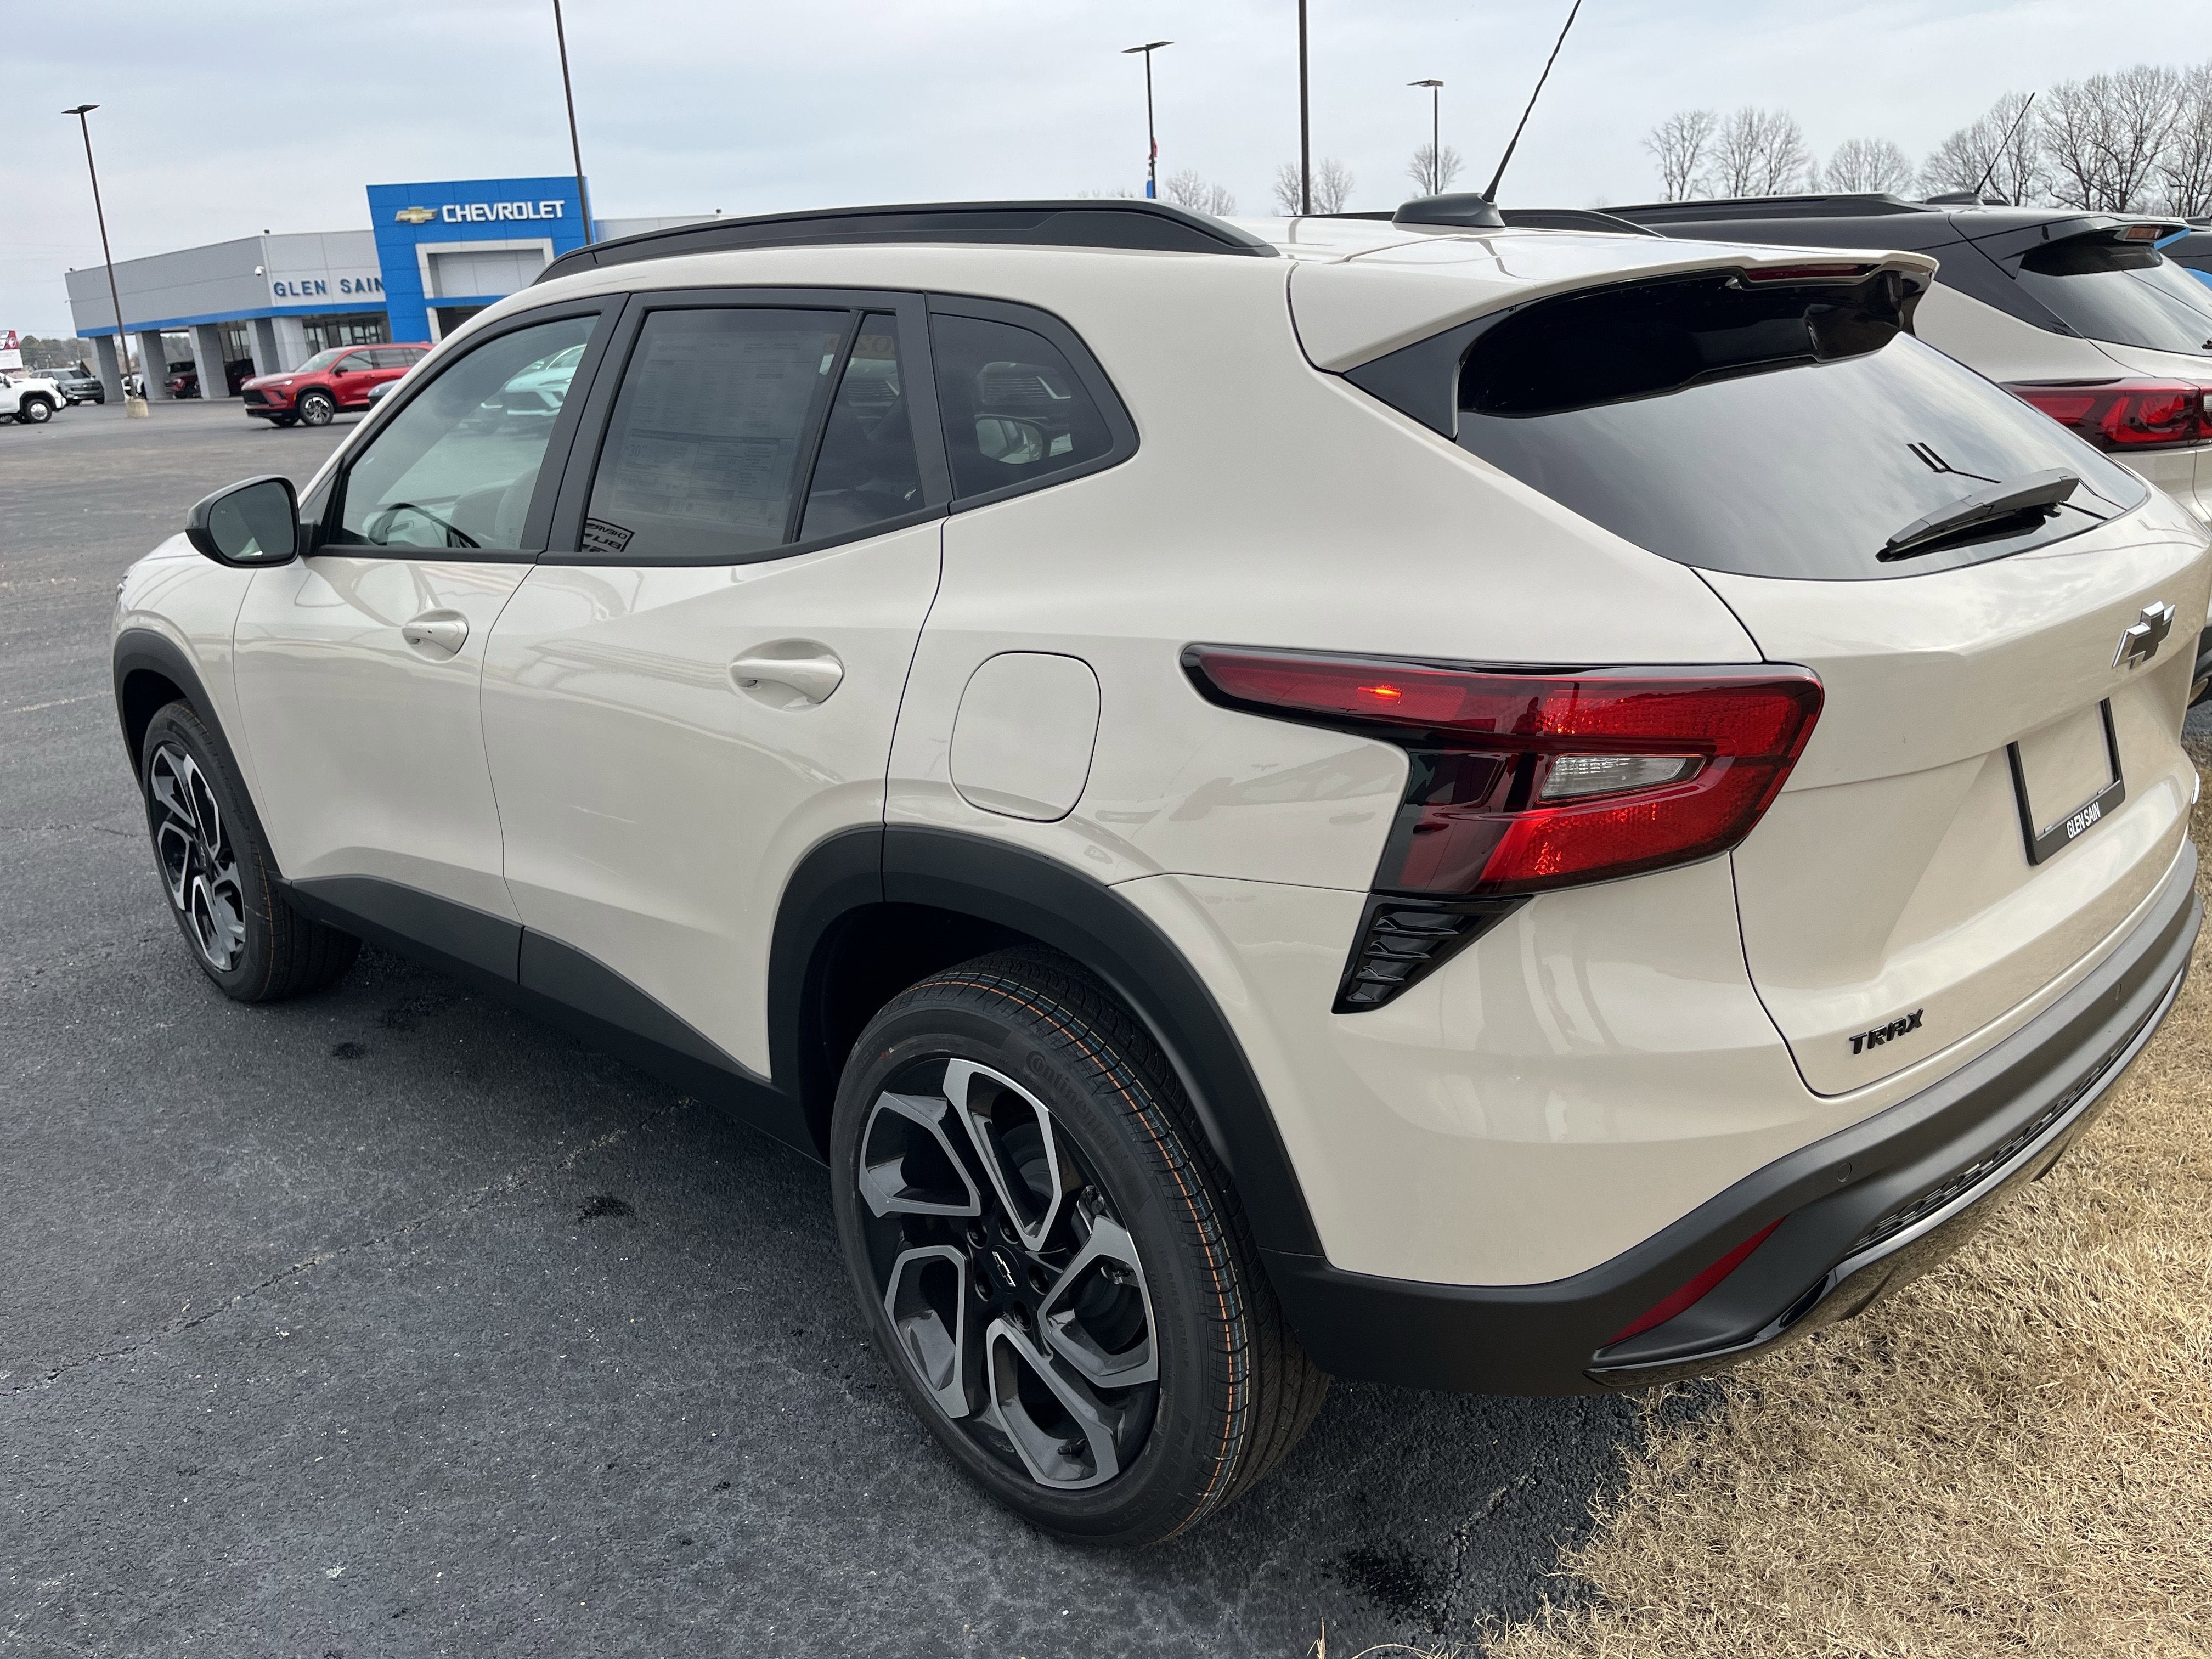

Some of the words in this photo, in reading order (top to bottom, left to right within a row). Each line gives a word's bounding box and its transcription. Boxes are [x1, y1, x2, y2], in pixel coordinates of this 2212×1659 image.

[442, 200, 565, 223] CHEVROLET
[274, 280, 327, 296] GLEN
[2067, 812, 2085, 839] GLEN
[2084, 802, 2101, 826] SAIN
[1849, 1008, 1923, 1054] TRAX
[1026, 1051, 1118, 1151] Continental
